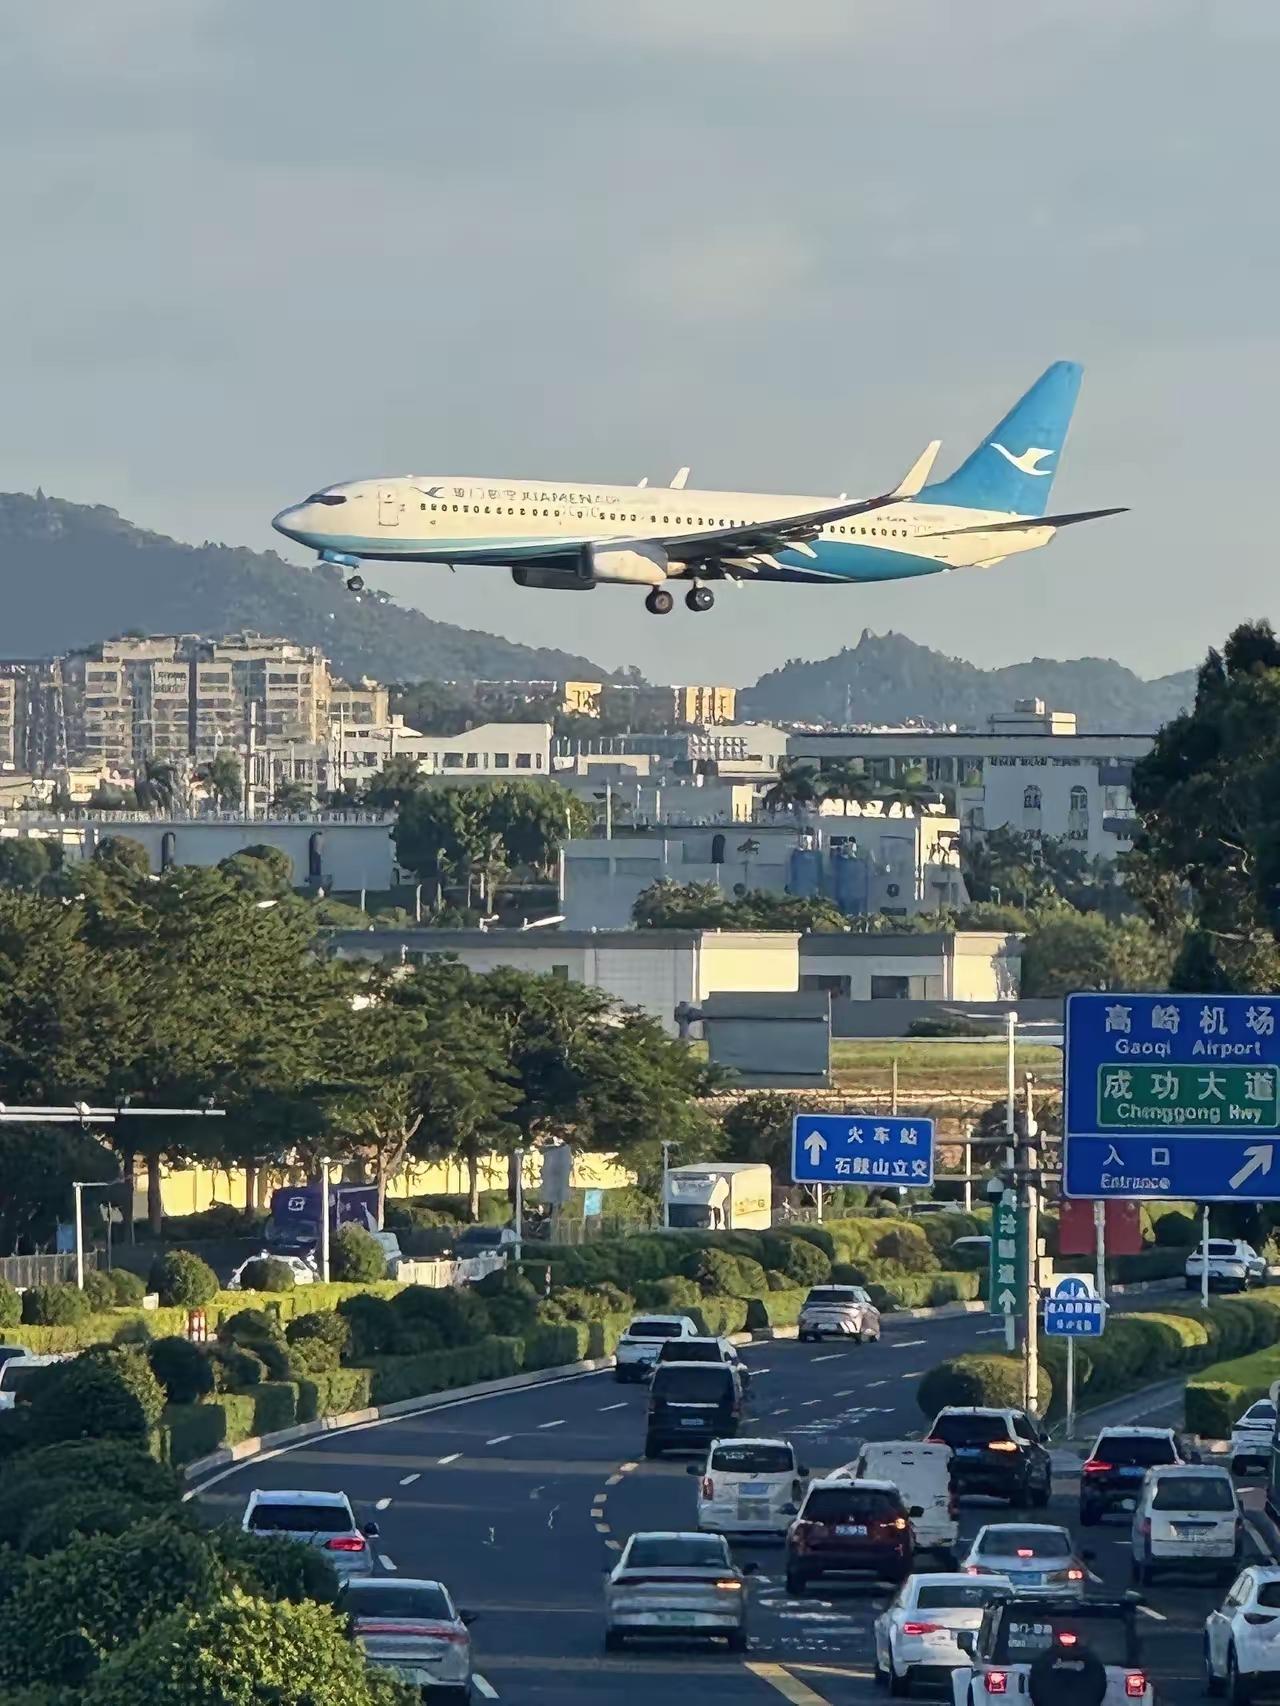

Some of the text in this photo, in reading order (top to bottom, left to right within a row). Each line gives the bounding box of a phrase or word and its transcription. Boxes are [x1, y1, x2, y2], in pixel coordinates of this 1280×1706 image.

[1104, 1004, 1275, 1035] 高崎机场
[1115, 1038, 1261, 1058] Gaoqi Airport
[1103, 1069, 1274, 1100] 成功大道
[847, 1125, 918, 1146] 火车站
[1102, 1144, 1170, 1166] 入口
